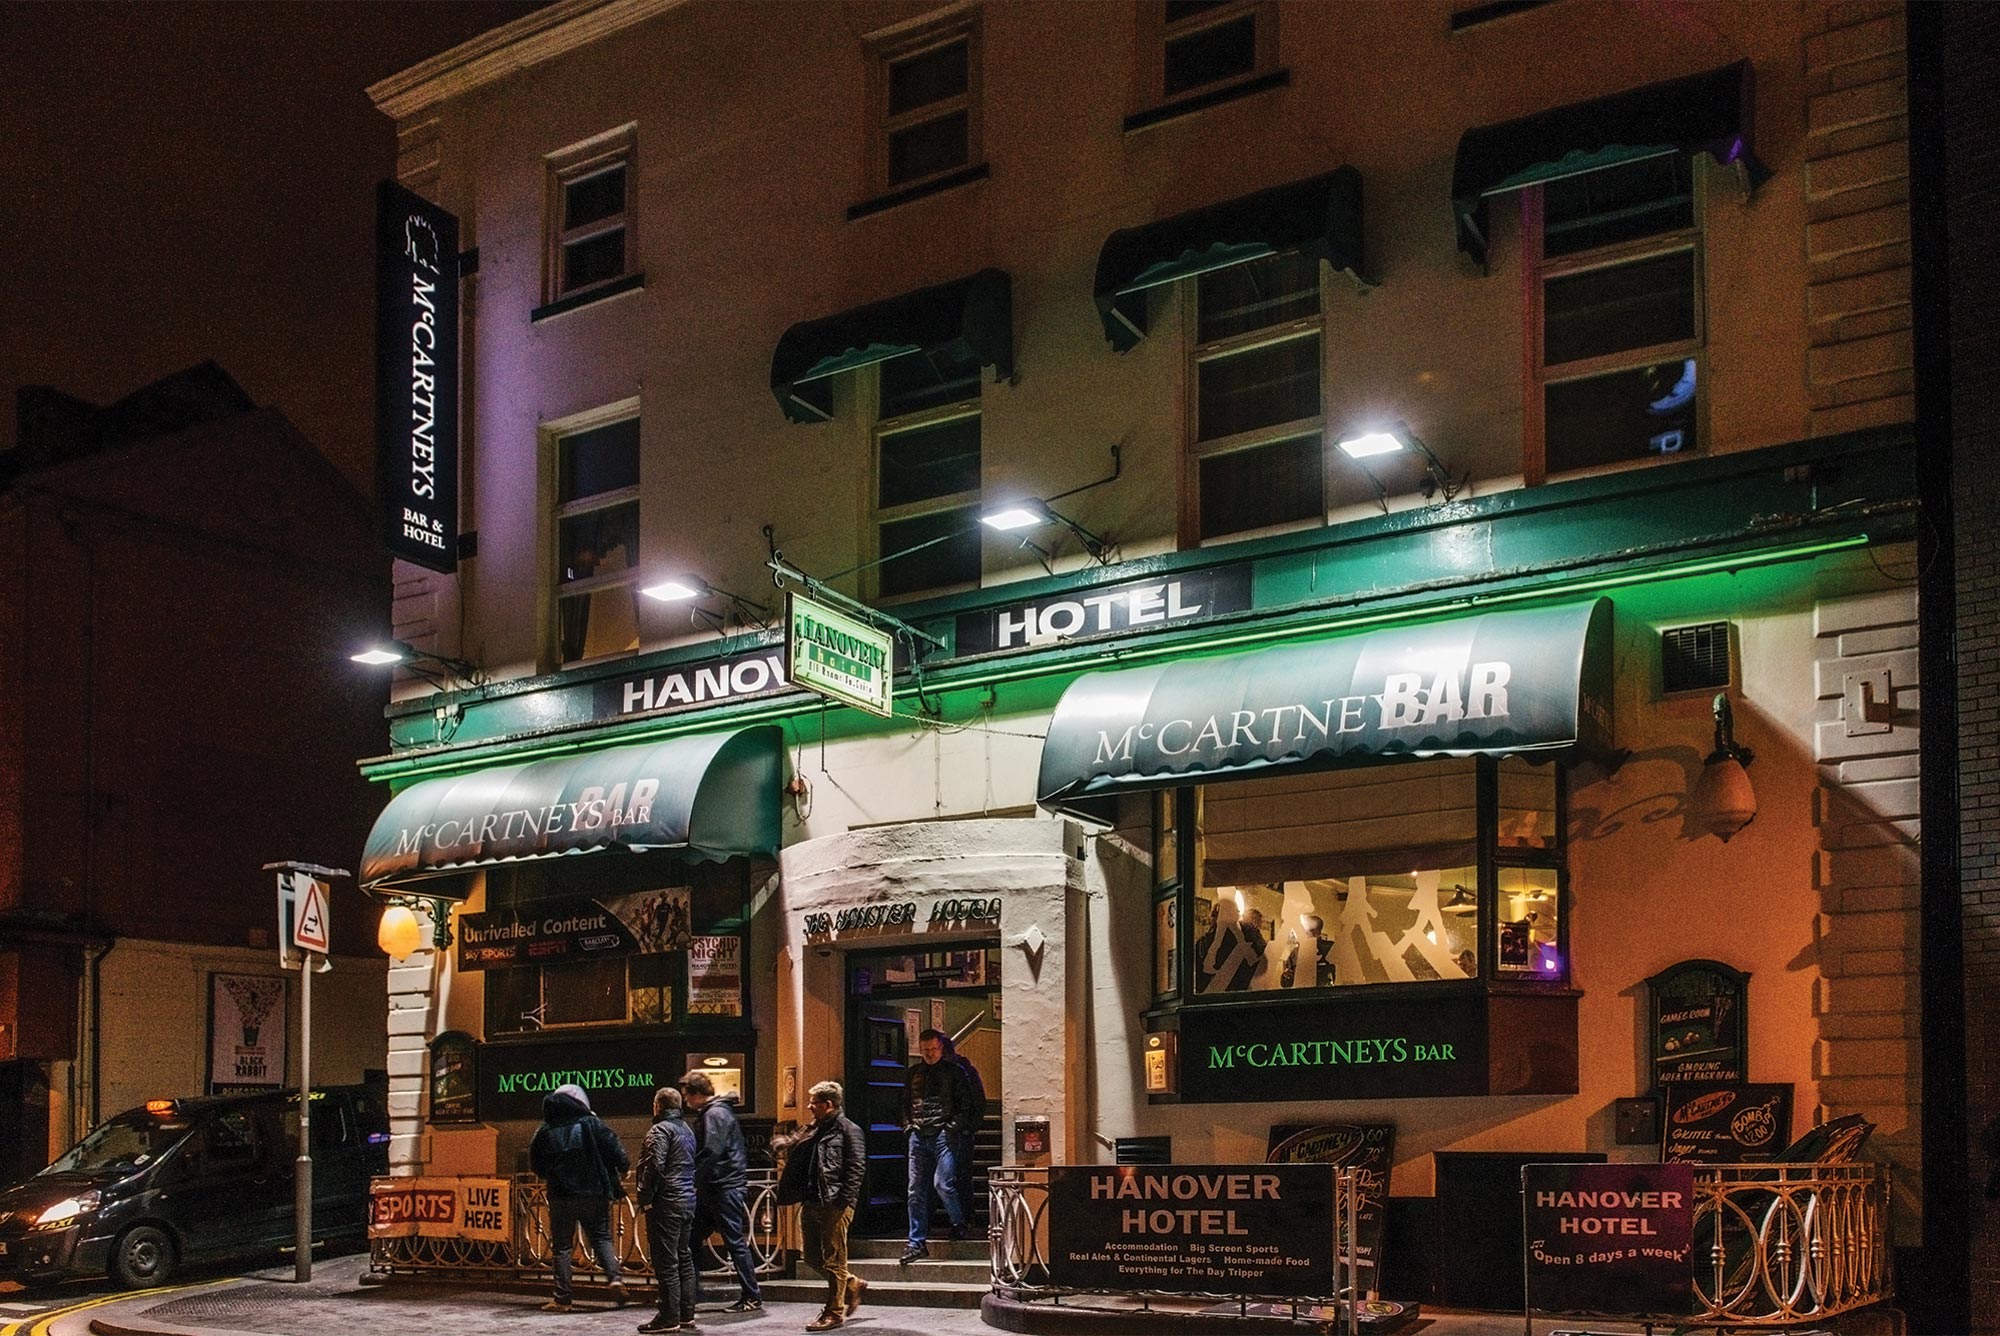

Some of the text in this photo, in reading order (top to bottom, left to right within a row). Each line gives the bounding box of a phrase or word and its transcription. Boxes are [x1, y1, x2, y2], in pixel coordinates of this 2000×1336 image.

[411, 272, 436, 500] McCARTNEYS
[403, 507, 443, 534] BAR &
[403, 523, 446, 551] HOTEL
[622, 581, 1203, 714] HANOV HOTEL
[803, 614, 882, 670] HANOVER
[1381, 661, 1511, 729] BAR
[394, 799, 650, 857] McCARTNEYS BAR
[464, 914, 607, 944] Unrivalled Content
[479, 945, 517, 959] SPORTS
[692, 937, 738, 949] PSYCHIC
[692, 949, 736, 959] NIGHT
[1208, 1037, 1456, 1069] McCARTNEYS BAR
[498, 1068, 655, 1093] McCARTNEYS BAR
[1733, 1109, 1771, 1134] BOMBS
[468, 1187, 500, 1207] LIVE
[1091, 1174, 1281, 1200] HANOVER
[377, 1194, 452, 1221] SPORTS
[1536, 1191, 1683, 1209] HANOVER
[38, 1216, 76, 1232] TAXI
[463, 1209, 503, 1231] HERE
[1122, 1209, 1249, 1236] HOTEL
[1559, 1217, 1657, 1235] HOTEL
[1069, 1252, 1311, 1267] Real Ales & Continental Lagers Home-made Food
[1104, 1241, 1279, 1255] Accommodation Big Screen Sports
[1533, 1246, 1683, 1265] Open 8 days a week
[1118, 1265, 1264, 1279] Everything for The Day Tripper
